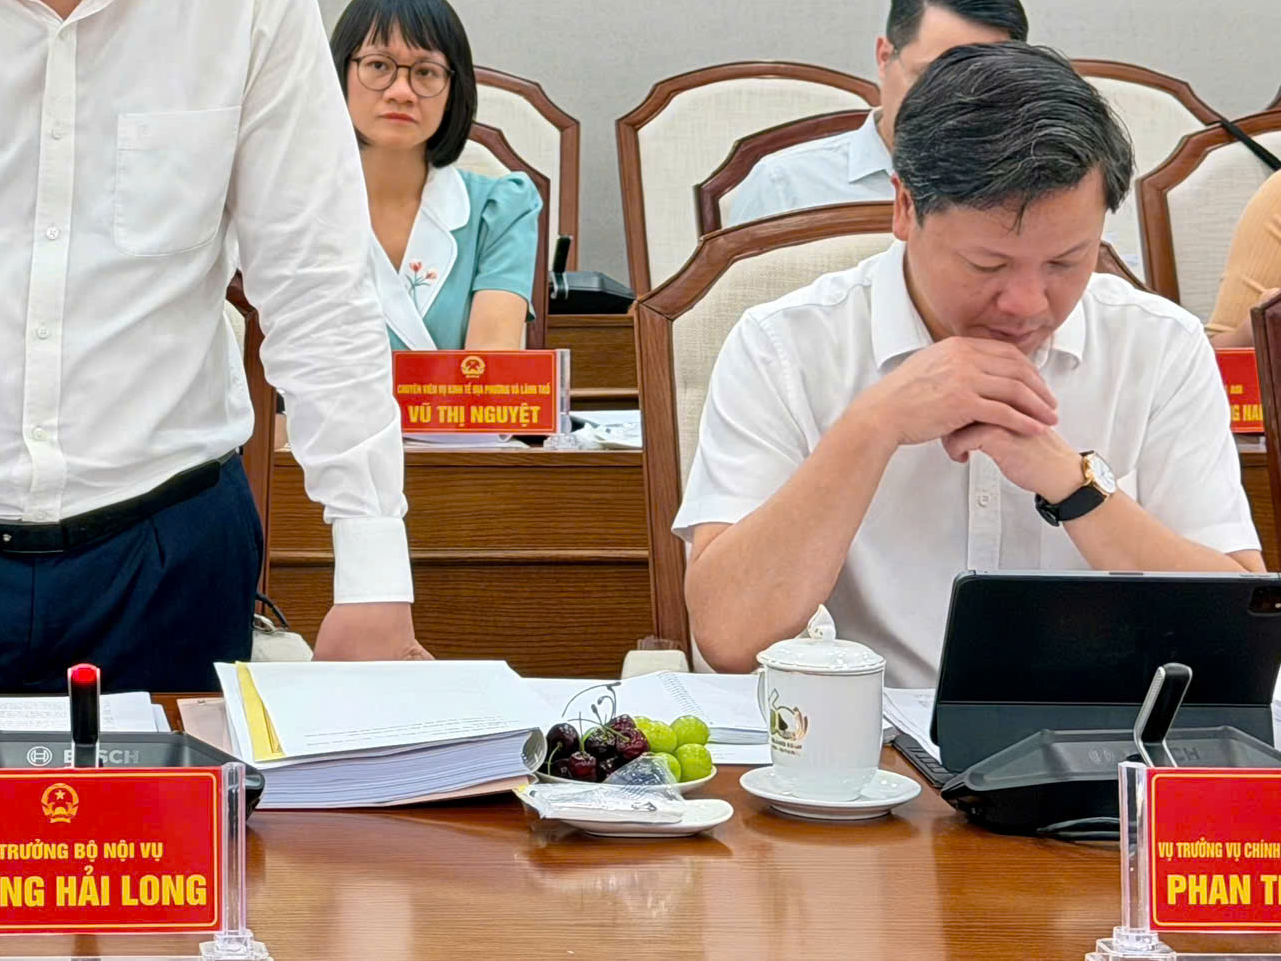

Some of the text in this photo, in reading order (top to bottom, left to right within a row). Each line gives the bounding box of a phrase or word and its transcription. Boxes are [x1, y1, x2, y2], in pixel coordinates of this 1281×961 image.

[407, 402, 541, 428] VŨ THỊ NGUYỆT
[63, 749, 140, 765] BSCH
[73, 839, 99, 862] BỘ
[103, 839, 135, 862] NỘI
[139, 841, 164, 862] VỤ
[1158, 836, 1281, 862] VỤ TRƯỞNG VỤ CHÍNH
[55, 865, 110, 907] HẢI
[121, 874, 207, 907] LONG
[1166, 874, 1252, 906] PHAN
